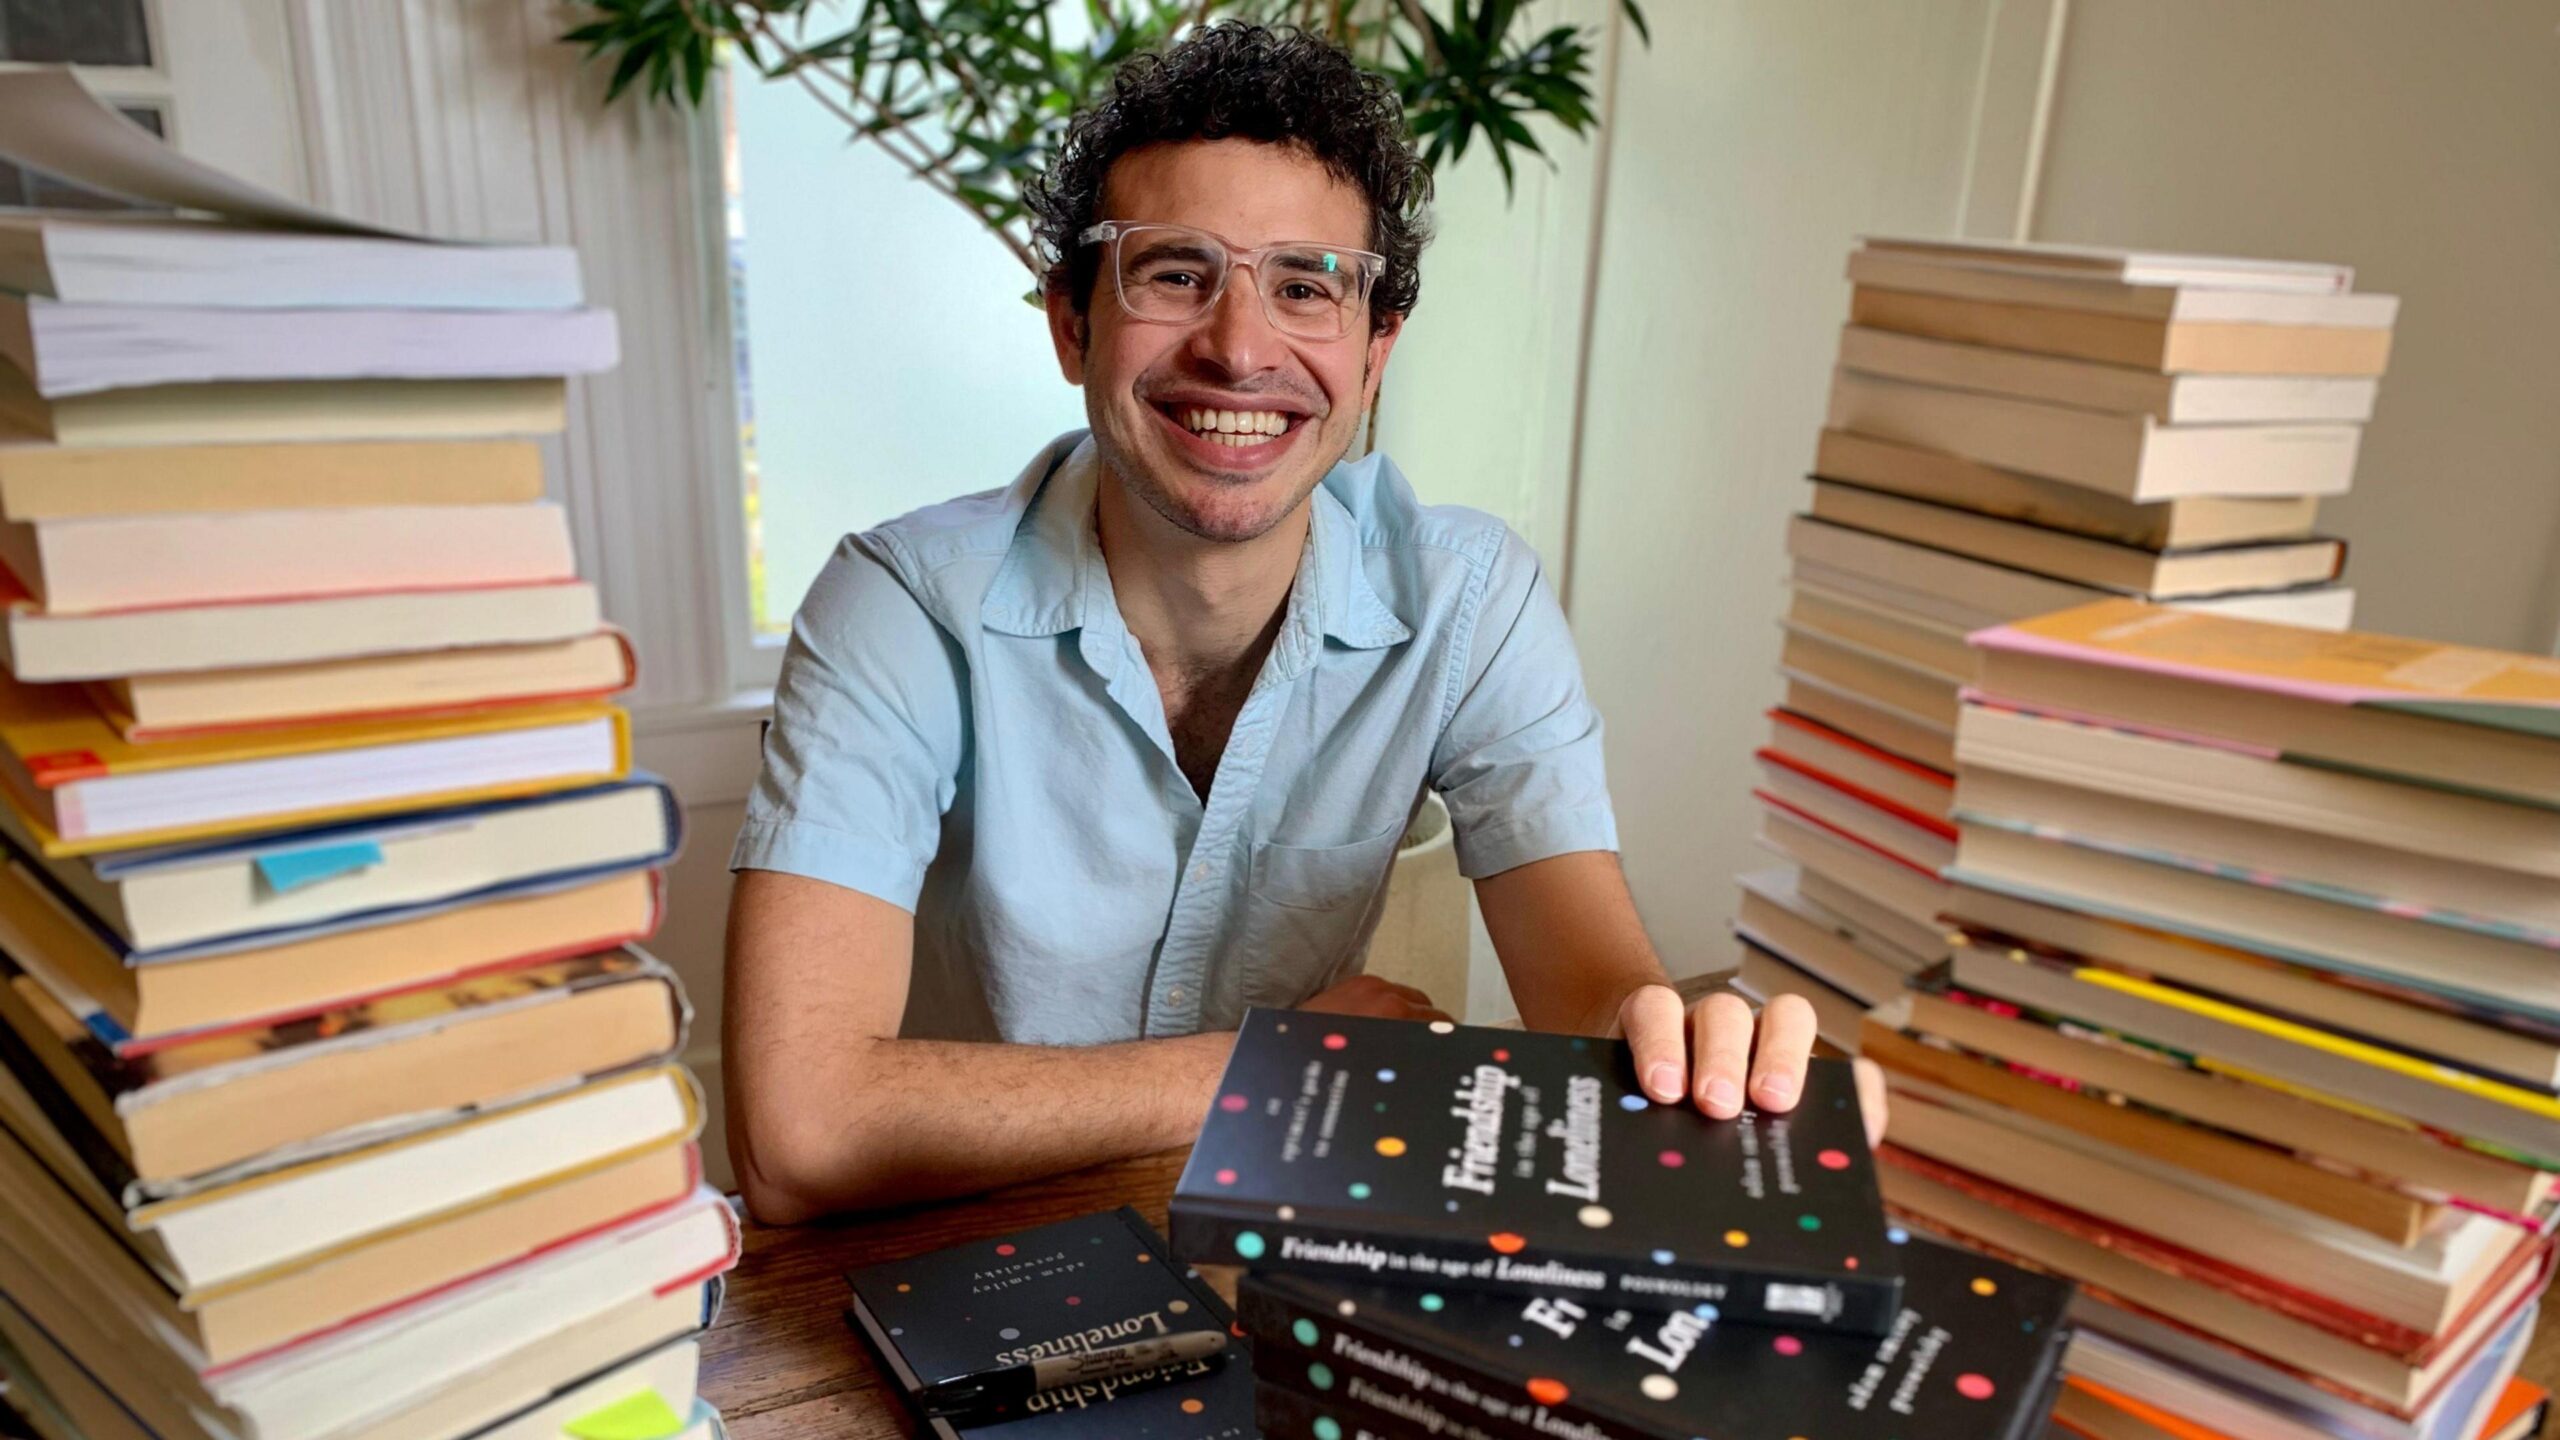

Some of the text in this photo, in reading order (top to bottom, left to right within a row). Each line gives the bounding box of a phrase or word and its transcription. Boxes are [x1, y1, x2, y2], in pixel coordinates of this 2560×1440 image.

[1442, 1064, 1522, 1195] Friendship
[1545, 1074, 1602, 1202] Loneliness
[972, 1261, 1085, 1294] adam smiley
[1281, 1236, 1608, 1291] Friendship in the age of Loneliness
[996, 1311, 1168, 1366] Loneliness
[1332, 1332, 1433, 1392] Friendship
[1430, 1372, 1452, 1396] in
[1449, 1380, 1480, 1407] the
[1347, 1376, 1448, 1435] Friendship
